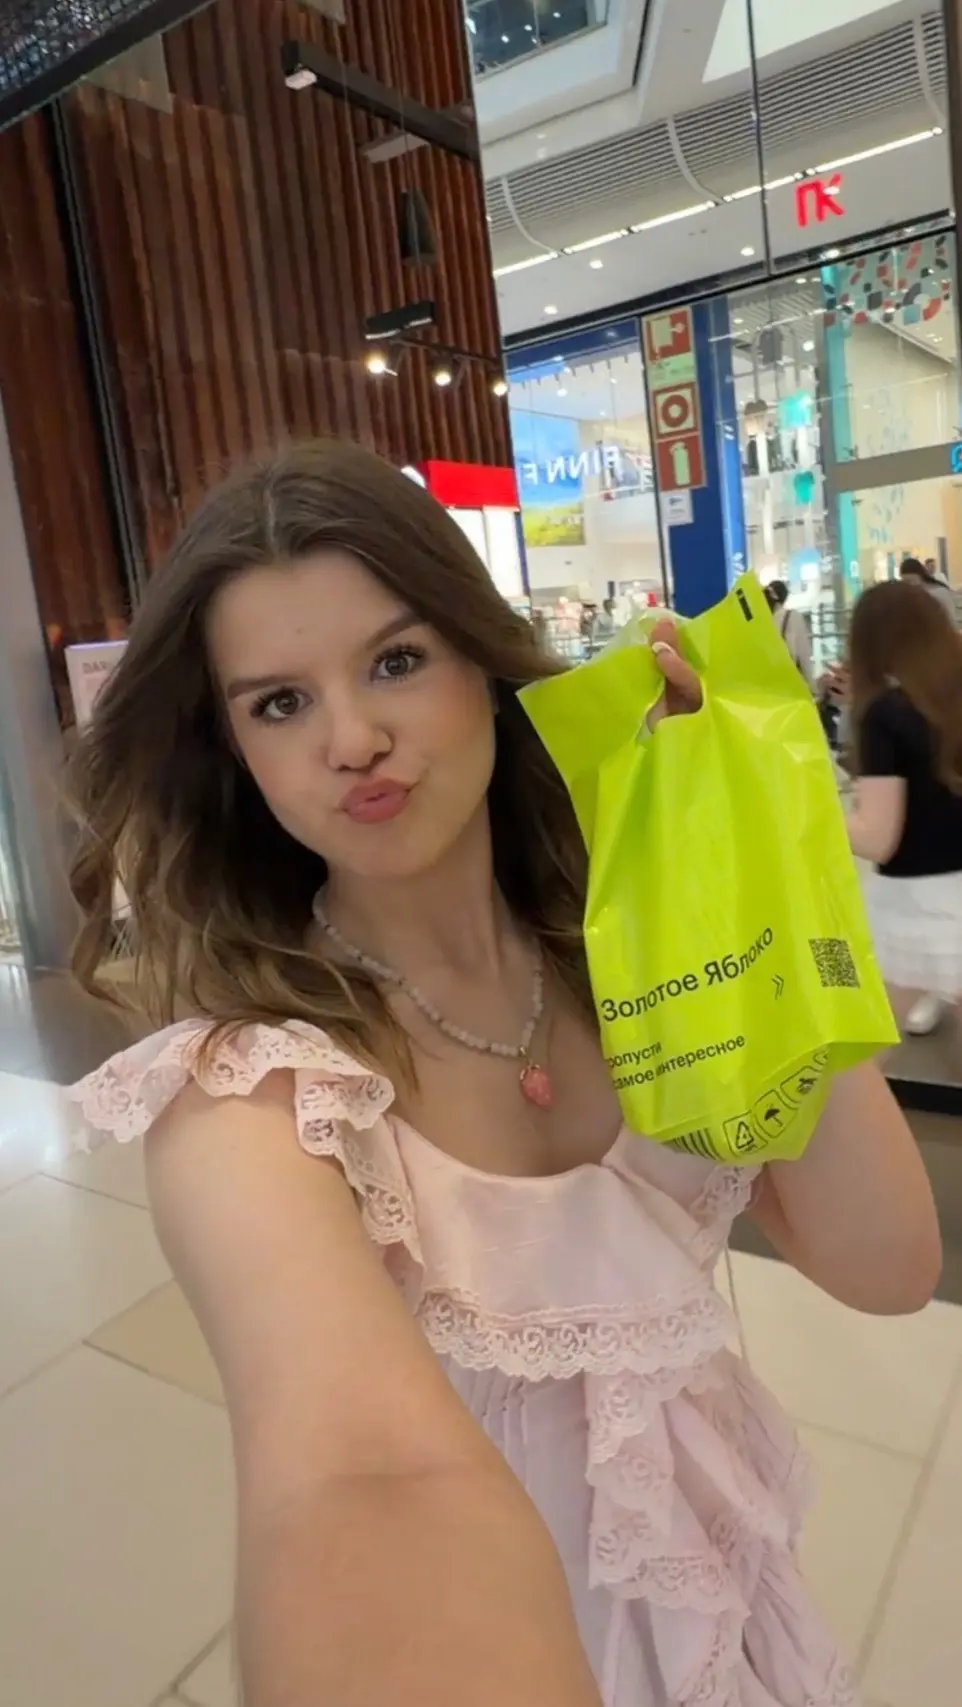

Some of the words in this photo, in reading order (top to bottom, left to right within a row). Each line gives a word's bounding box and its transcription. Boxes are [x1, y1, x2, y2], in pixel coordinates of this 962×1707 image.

[601, 973, 699, 1022] Золотое
[704, 927, 773, 986] Яблоко
[655, 1035, 746, 1077] интересное
